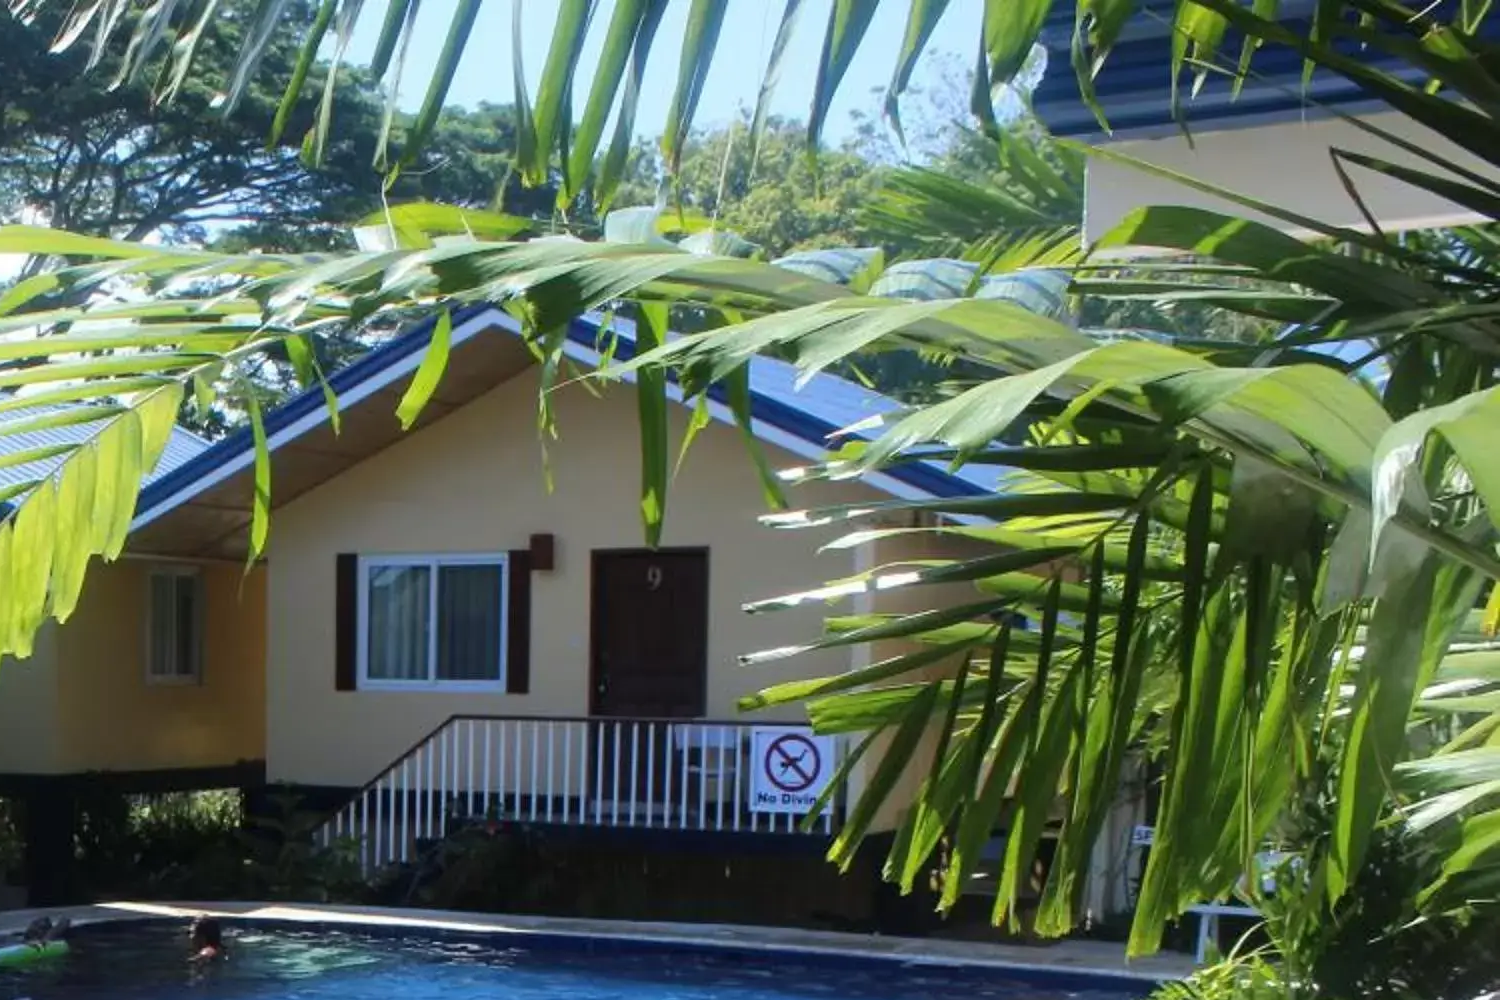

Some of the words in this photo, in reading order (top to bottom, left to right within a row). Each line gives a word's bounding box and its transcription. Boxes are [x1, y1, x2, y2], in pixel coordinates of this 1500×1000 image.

[647, 566, 662, 590] 9
[757, 793, 777, 804] No
[781, 793, 819, 805] Divin
